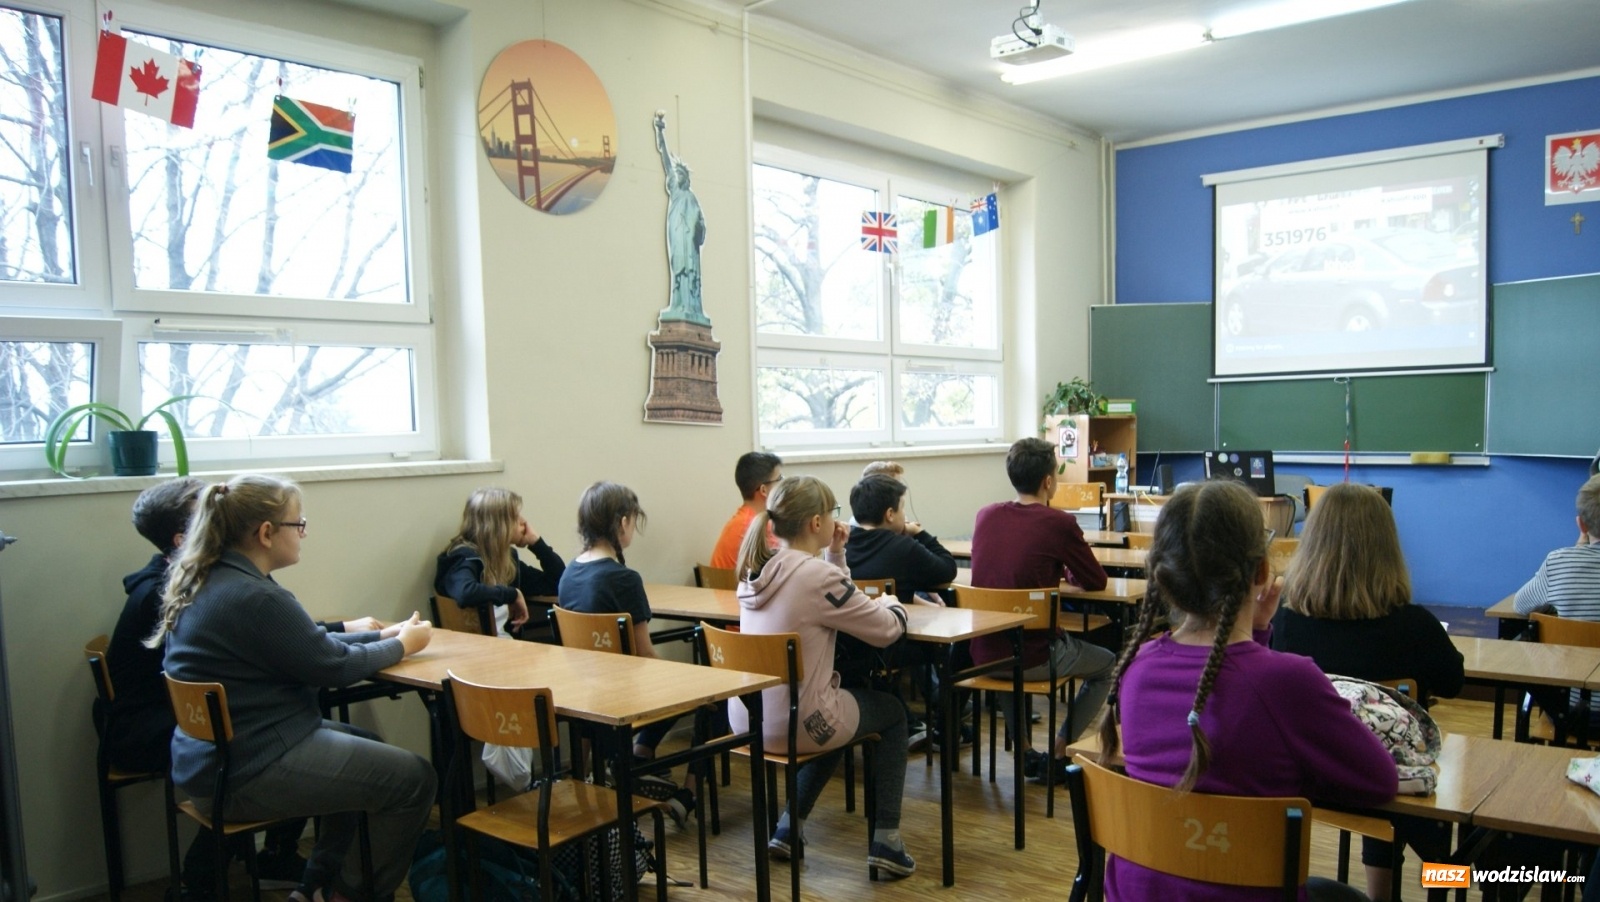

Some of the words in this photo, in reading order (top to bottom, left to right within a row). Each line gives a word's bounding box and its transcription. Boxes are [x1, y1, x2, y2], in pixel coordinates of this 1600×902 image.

[1264, 226, 1327, 247] 351976
[1080, 491, 1094, 502] 24
[591, 631, 613, 648] 24
[710, 643, 725, 665] 24
[186, 702, 206, 725] 24
[495, 711, 523, 736] 24
[808, 721, 829, 740] NYC
[1183, 818, 1232, 854] 24
